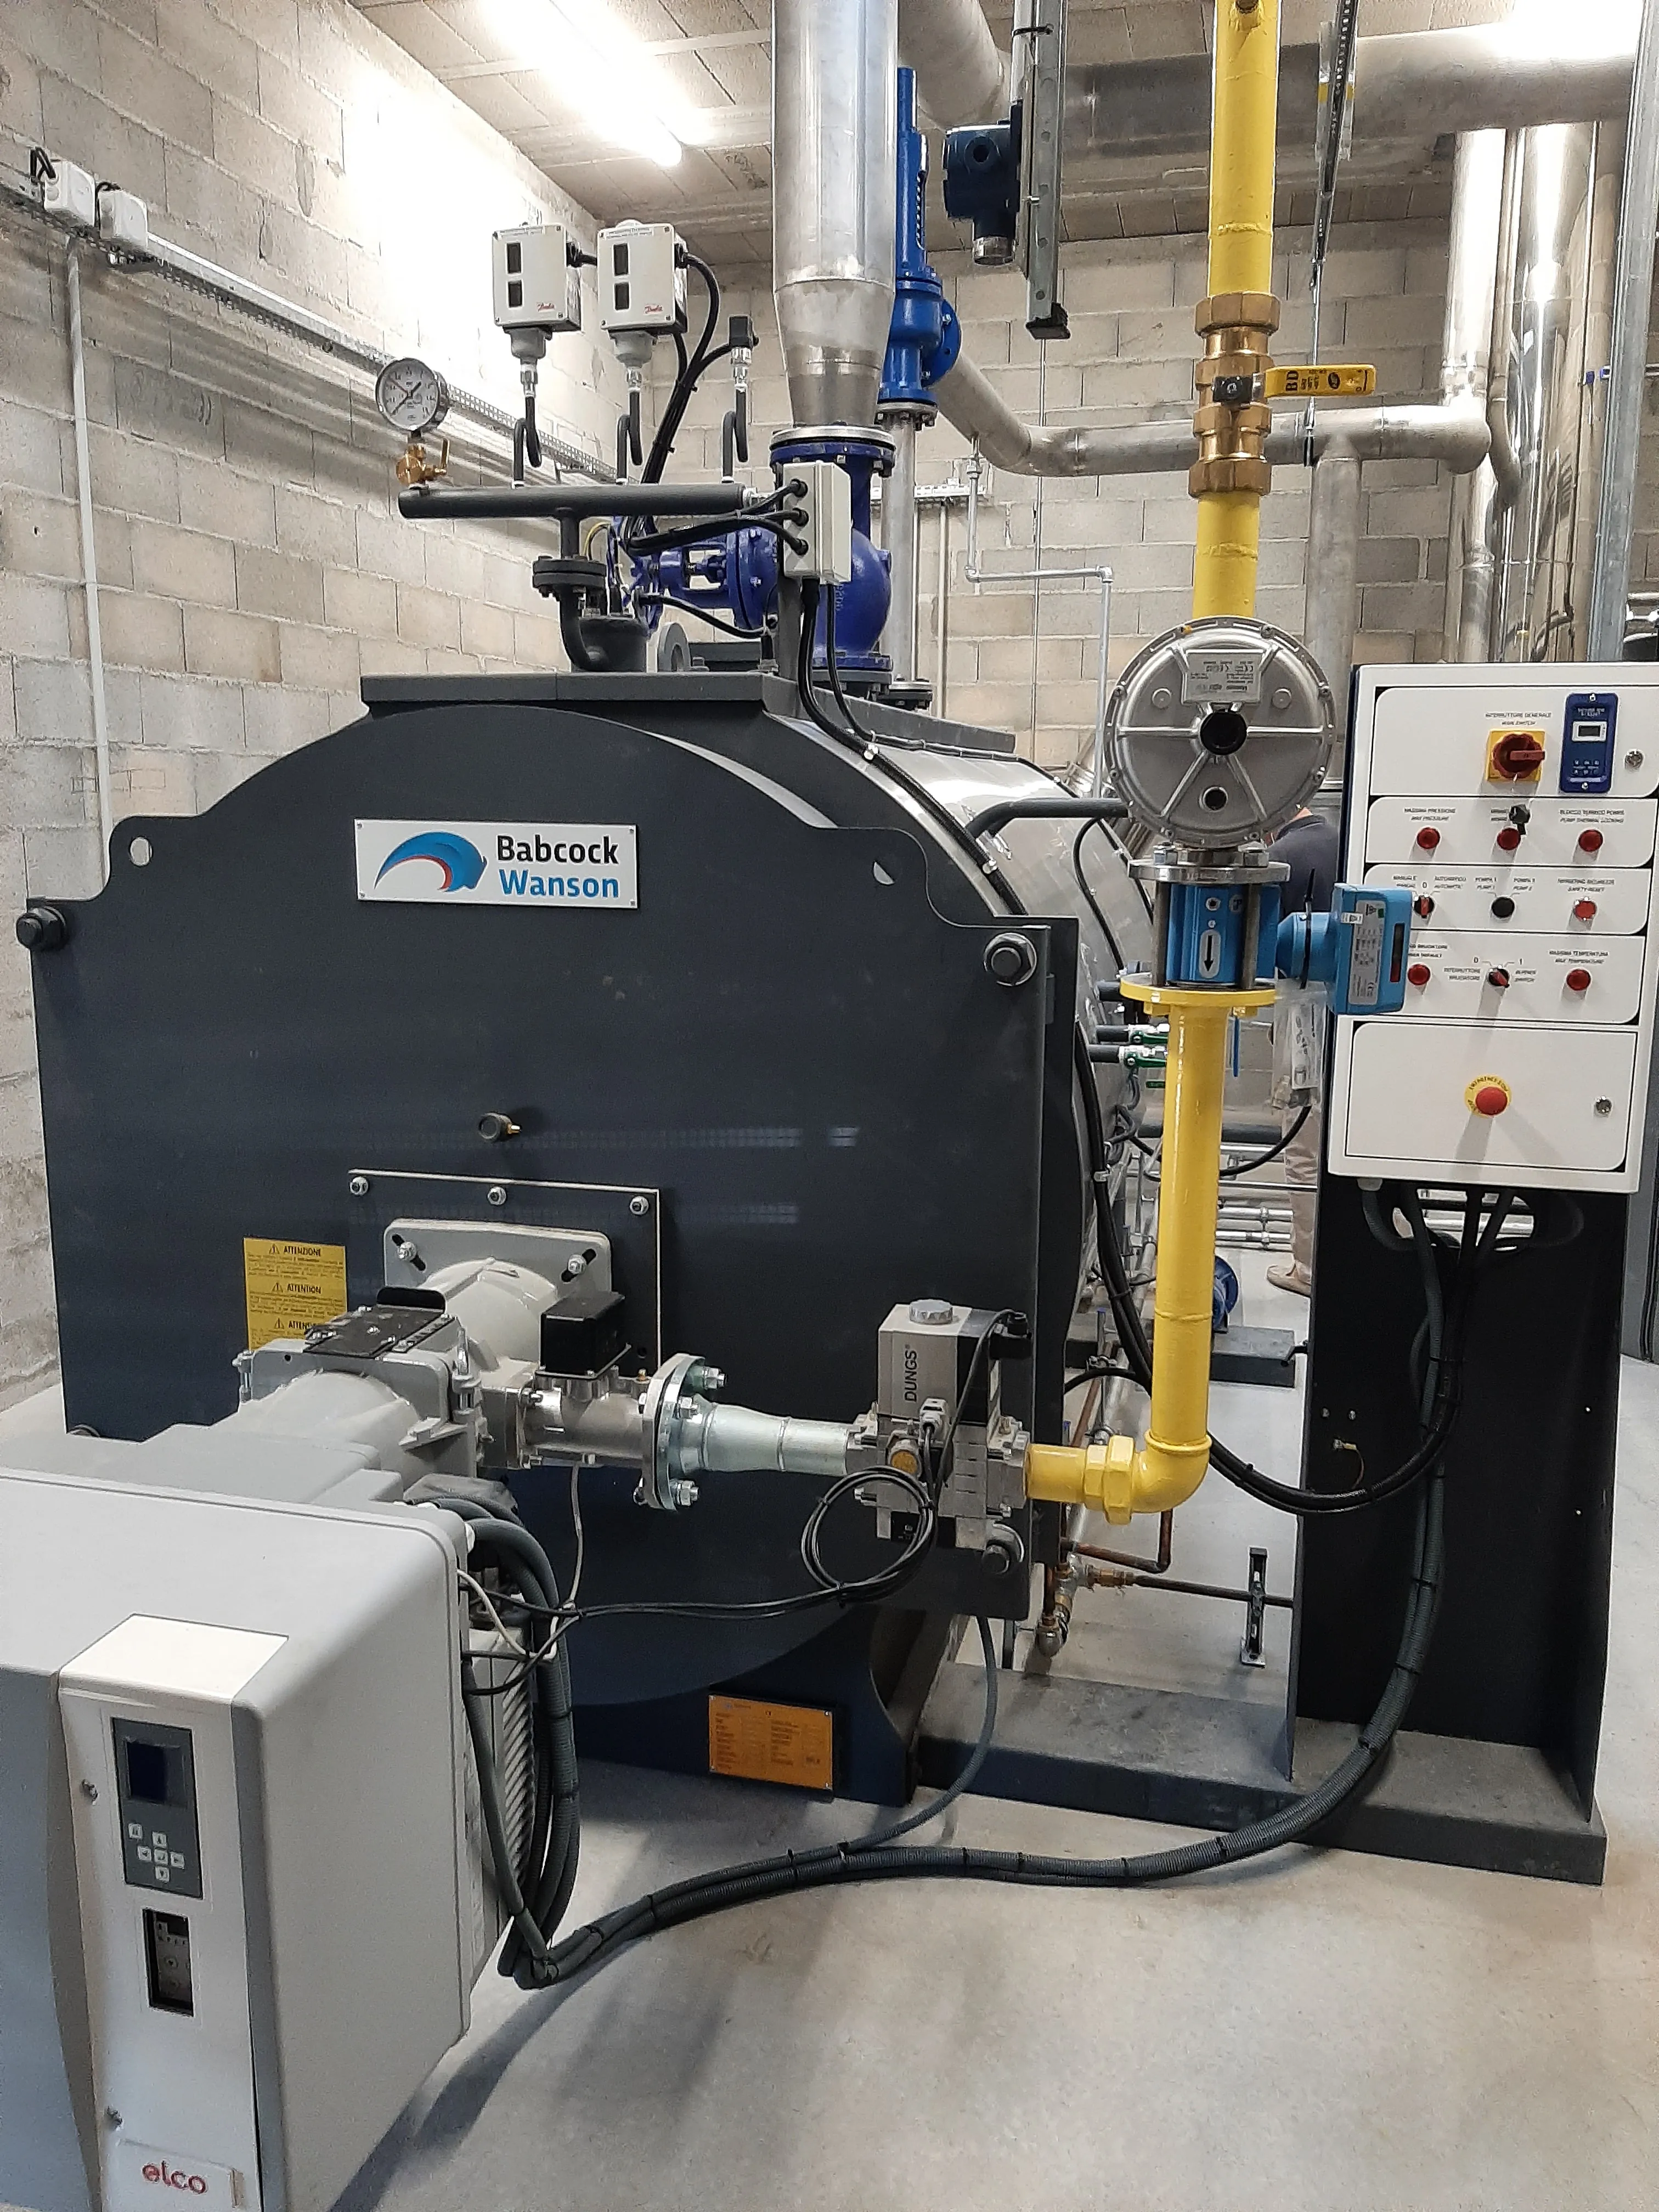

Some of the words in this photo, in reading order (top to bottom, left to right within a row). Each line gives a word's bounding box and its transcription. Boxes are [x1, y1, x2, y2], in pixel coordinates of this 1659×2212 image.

[497, 834, 619, 864] Babcock
[499, 868, 619, 898] Wanson
[284, 1245, 321, 1257] ATTENZIONE
[286, 1283, 322, 1294] ATTENTION
[904, 1350, 917, 1402] DUNGS
[142, 2159, 207, 2194] elco
